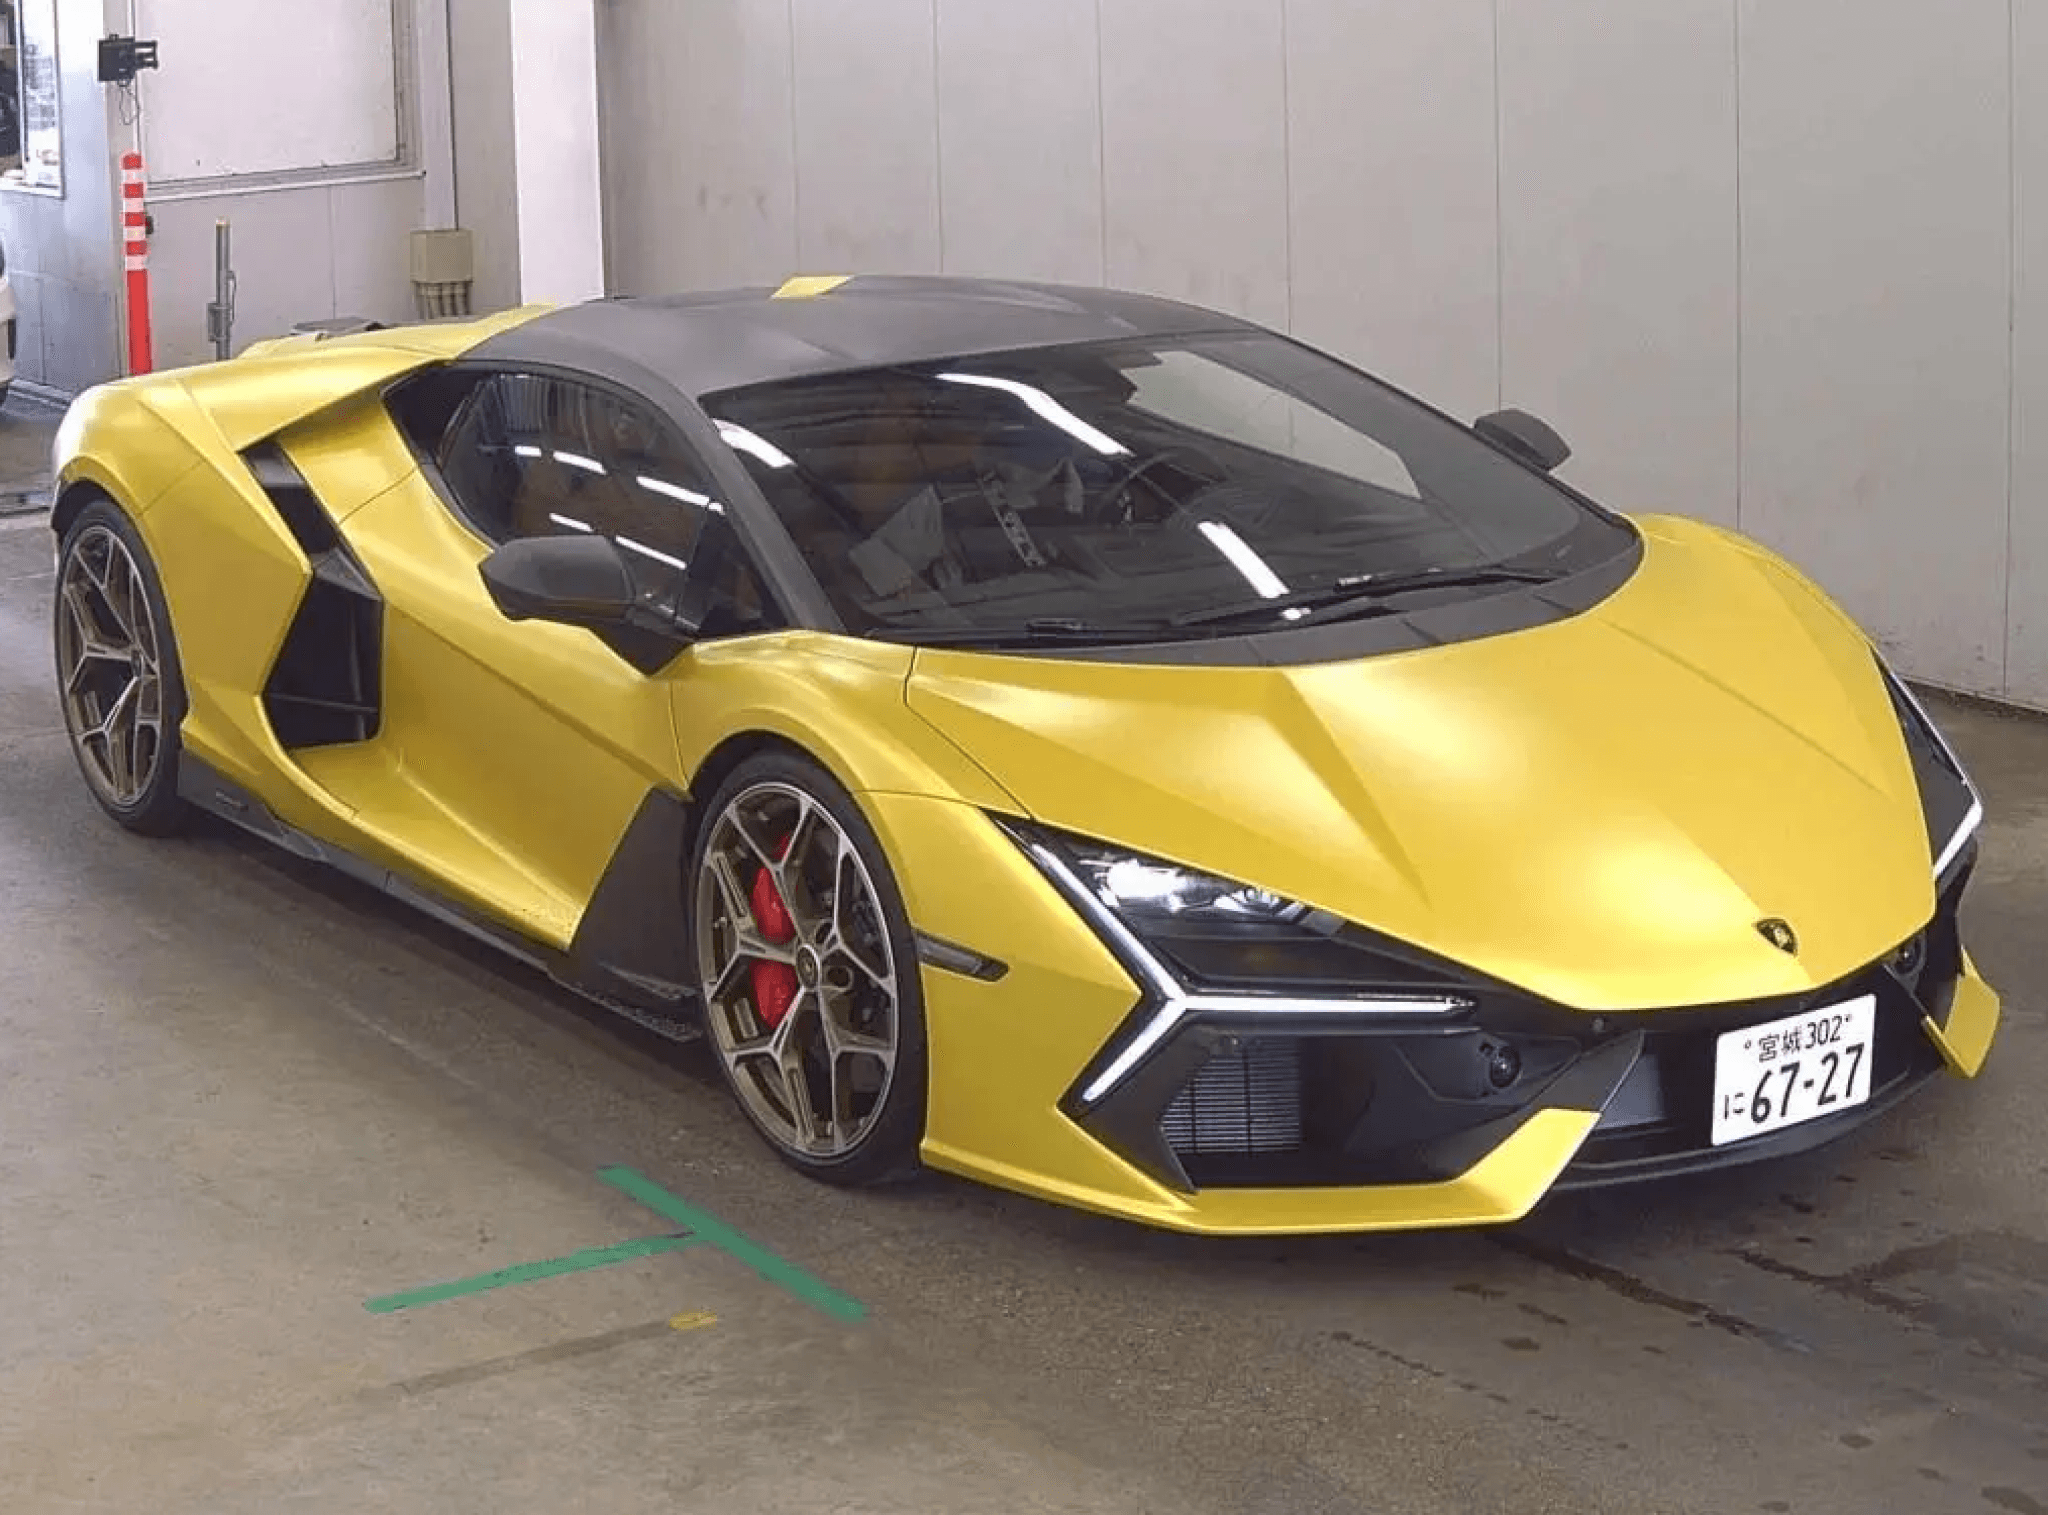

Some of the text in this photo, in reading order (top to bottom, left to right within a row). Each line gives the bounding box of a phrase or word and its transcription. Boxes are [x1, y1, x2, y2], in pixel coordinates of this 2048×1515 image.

[1758, 1015, 1842, 1063] 宮城 302
[1724, 1042, 1865, 1124] に 67-27
